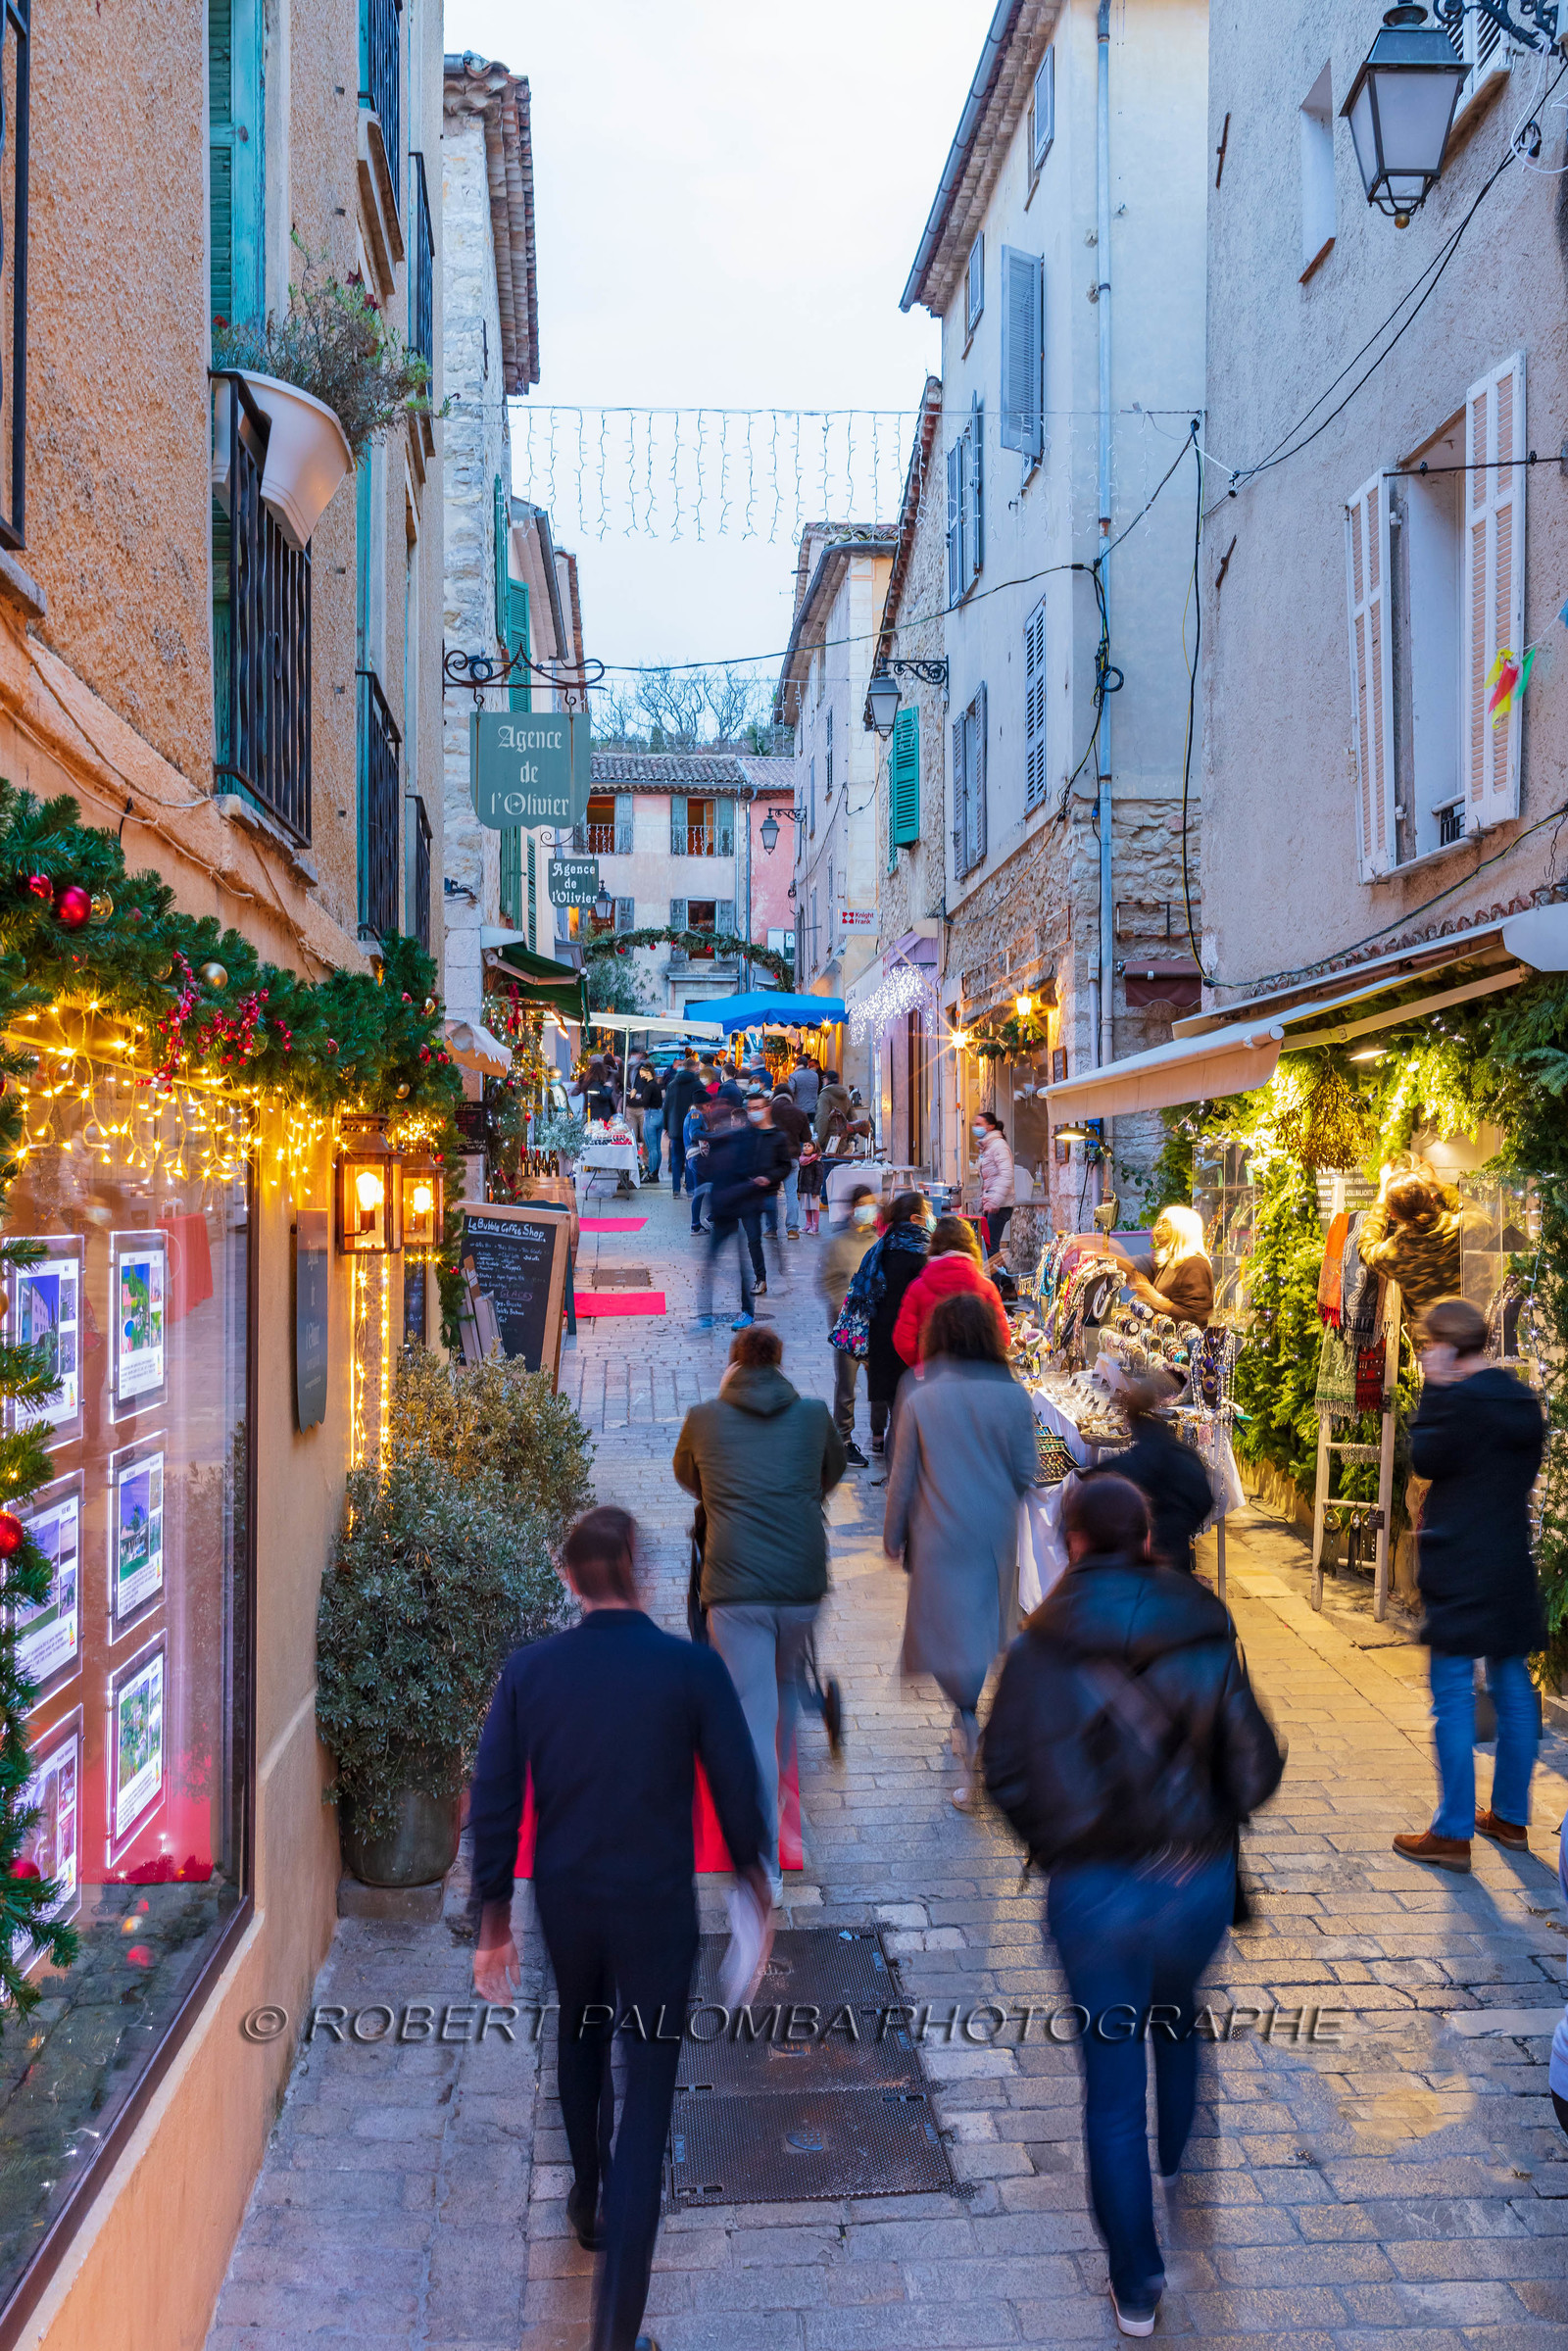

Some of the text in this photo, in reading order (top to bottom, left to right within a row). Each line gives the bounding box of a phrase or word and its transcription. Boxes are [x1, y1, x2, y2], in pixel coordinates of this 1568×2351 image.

[498, 725, 563, 753] Agence
[519, 760, 539, 783] de
[491, 792, 569, 816] l'Olivier
[552, 862, 596, 877] Agence
[564, 877, 577, 889] de
[552, 890, 598, 904] l'Olivier
[467, 1217, 545, 1240] Le Bubble Coffee Shop
